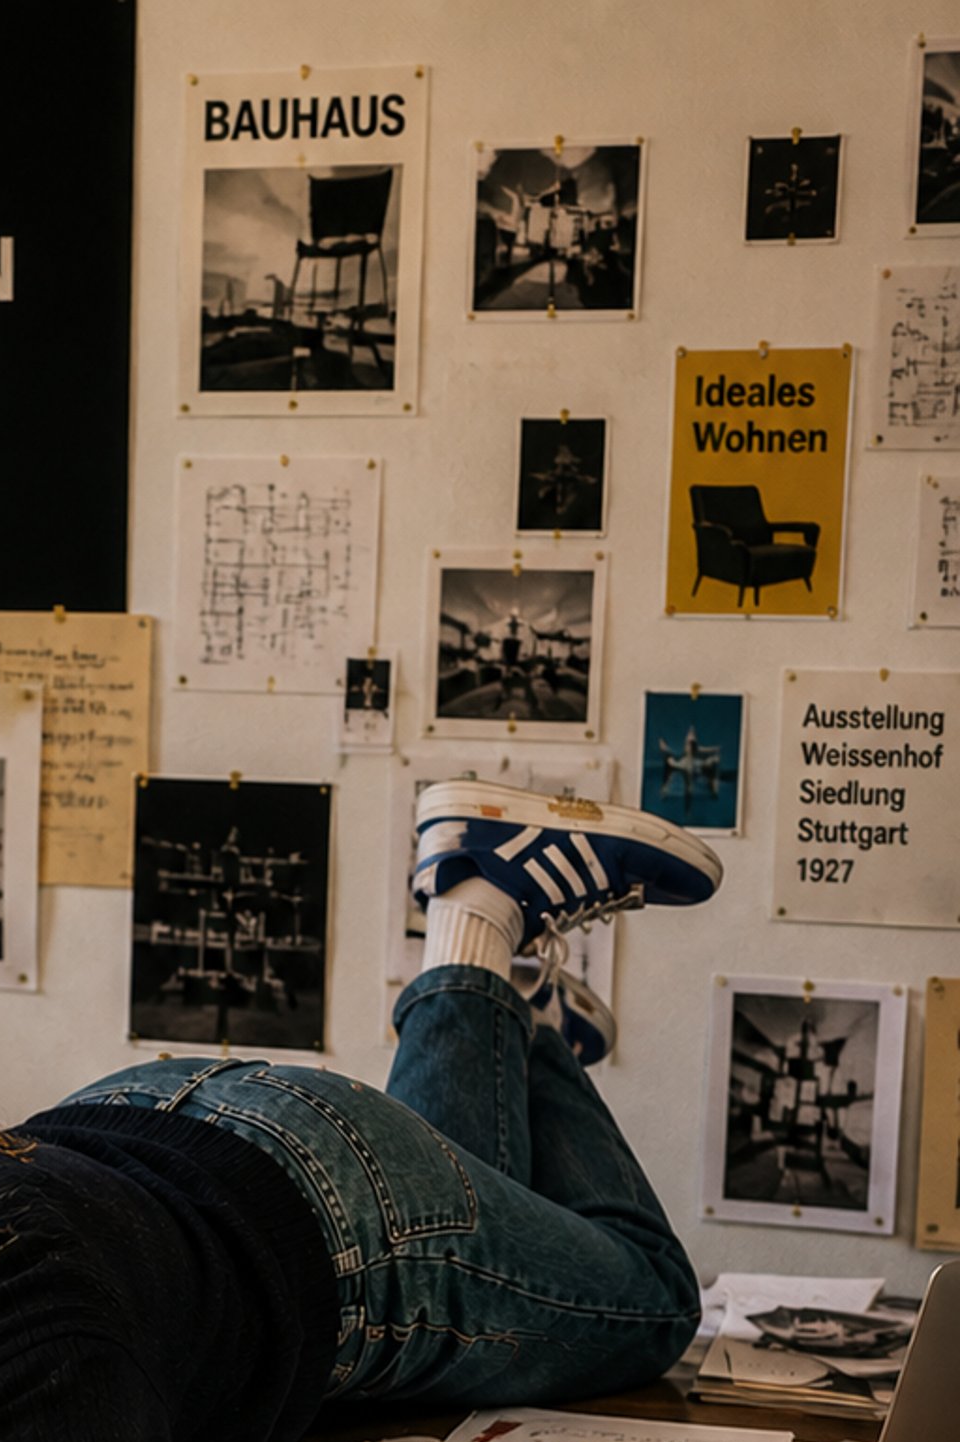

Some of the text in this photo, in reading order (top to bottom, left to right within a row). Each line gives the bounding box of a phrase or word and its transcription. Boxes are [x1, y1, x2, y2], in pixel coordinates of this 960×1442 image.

[204, 93, 406, 142] BAUHAUS
[695, 373, 815, 408] Ideales
[692, 420, 828, 453] Wohnen
[802, 703, 945, 737] Ausstellung
[801, 741, 944, 769] Weissenhof
[799, 778, 906, 813] Siedlung
[797, 817, 909, 851] Stuttgart
[797, 857, 855, 884] 1927
